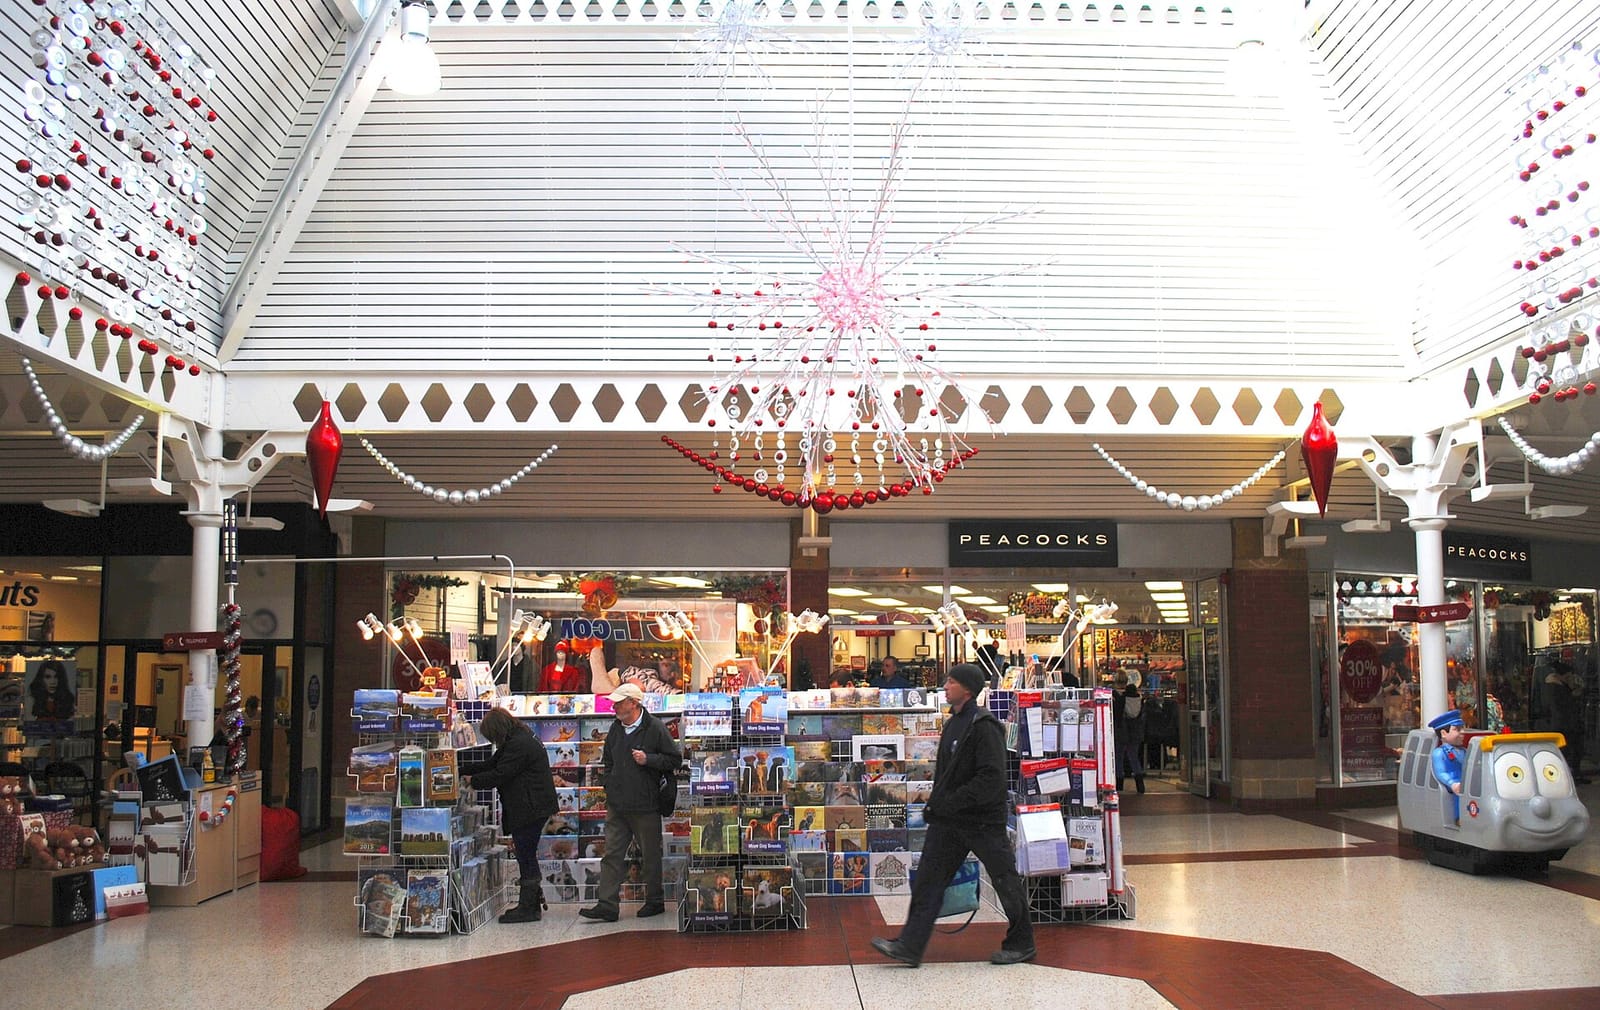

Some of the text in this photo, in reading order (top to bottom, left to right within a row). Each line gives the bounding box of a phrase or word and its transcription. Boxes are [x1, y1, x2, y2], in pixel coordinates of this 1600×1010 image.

[960, 534, 1108, 545] PEACOCKS
[1447, 545, 1528, 562] PEACOCKS
[1346, 659, 1377, 677] 30%
[1352, 677, 1372, 690] OFF
